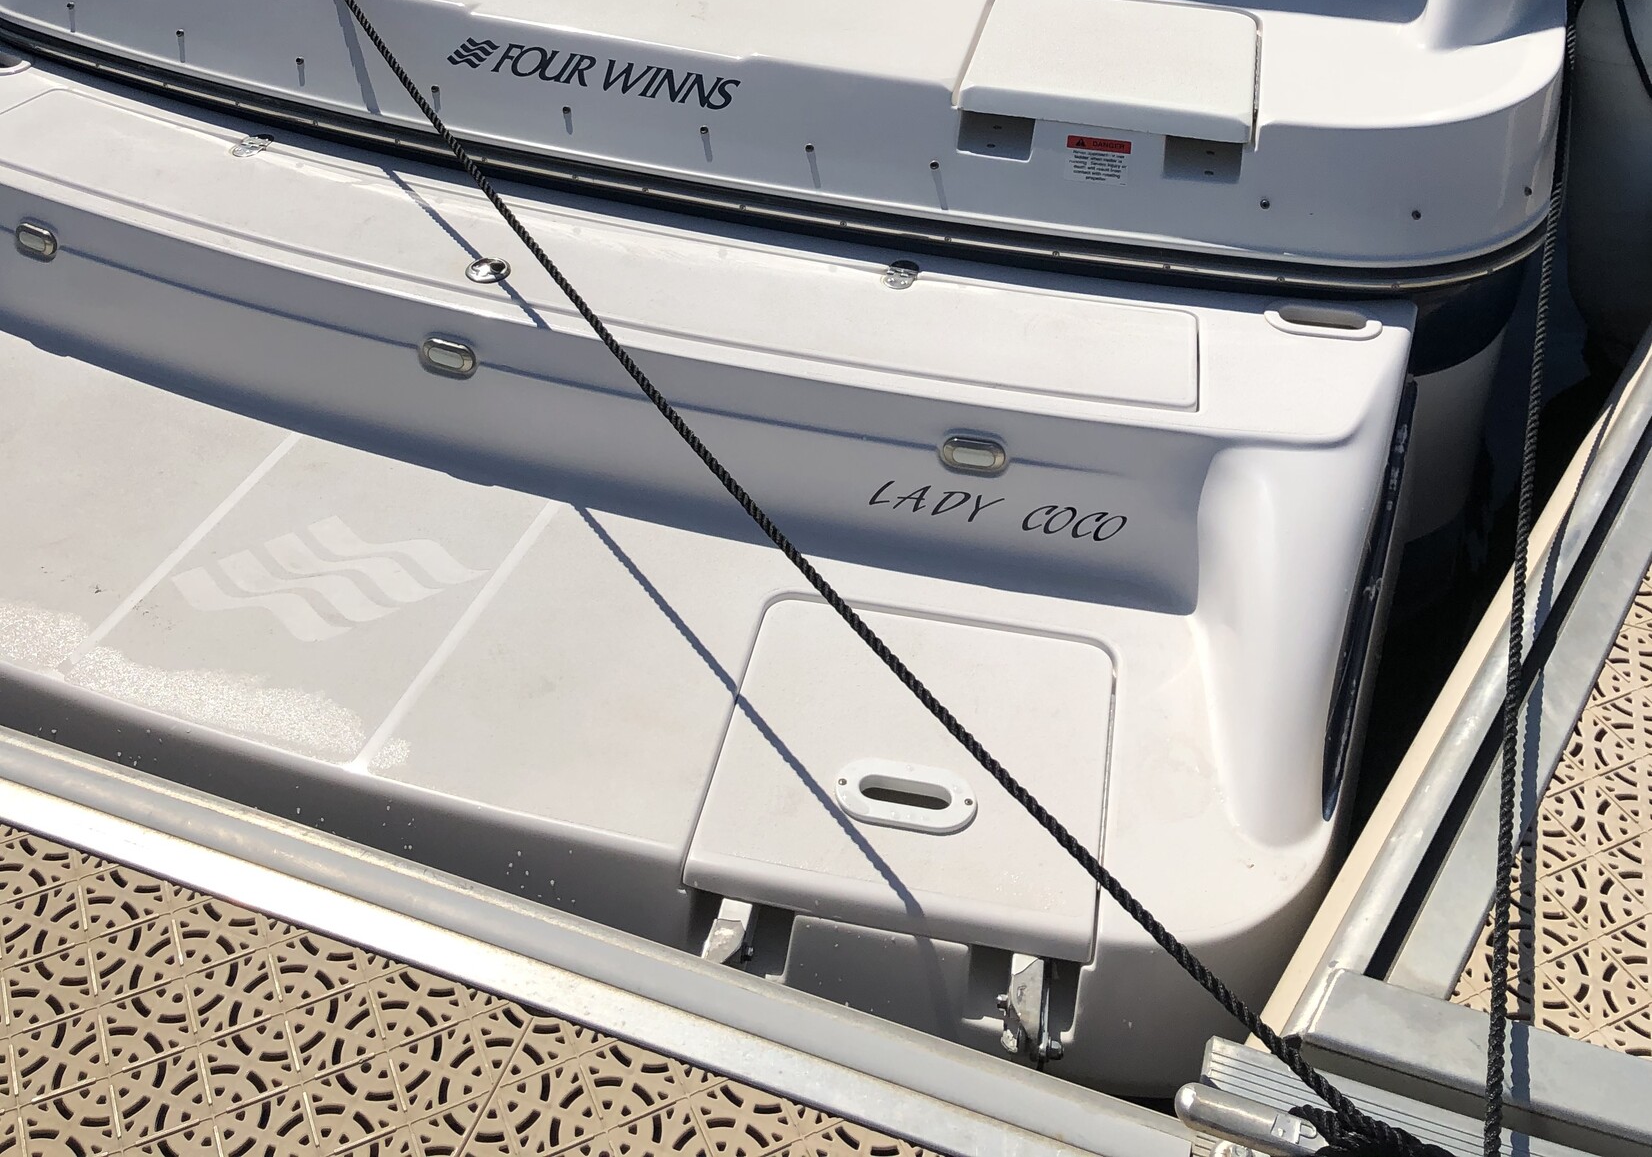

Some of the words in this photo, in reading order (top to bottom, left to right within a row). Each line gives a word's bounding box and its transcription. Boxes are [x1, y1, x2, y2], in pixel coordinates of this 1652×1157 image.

[490, 43, 597, 87] FOUR
[602, 59, 741, 110] WINNS
[1092, 140, 1125, 149] DANGER
[868, 480, 1005, 523] LADY
[1021, 505, 1127, 542] COCO
